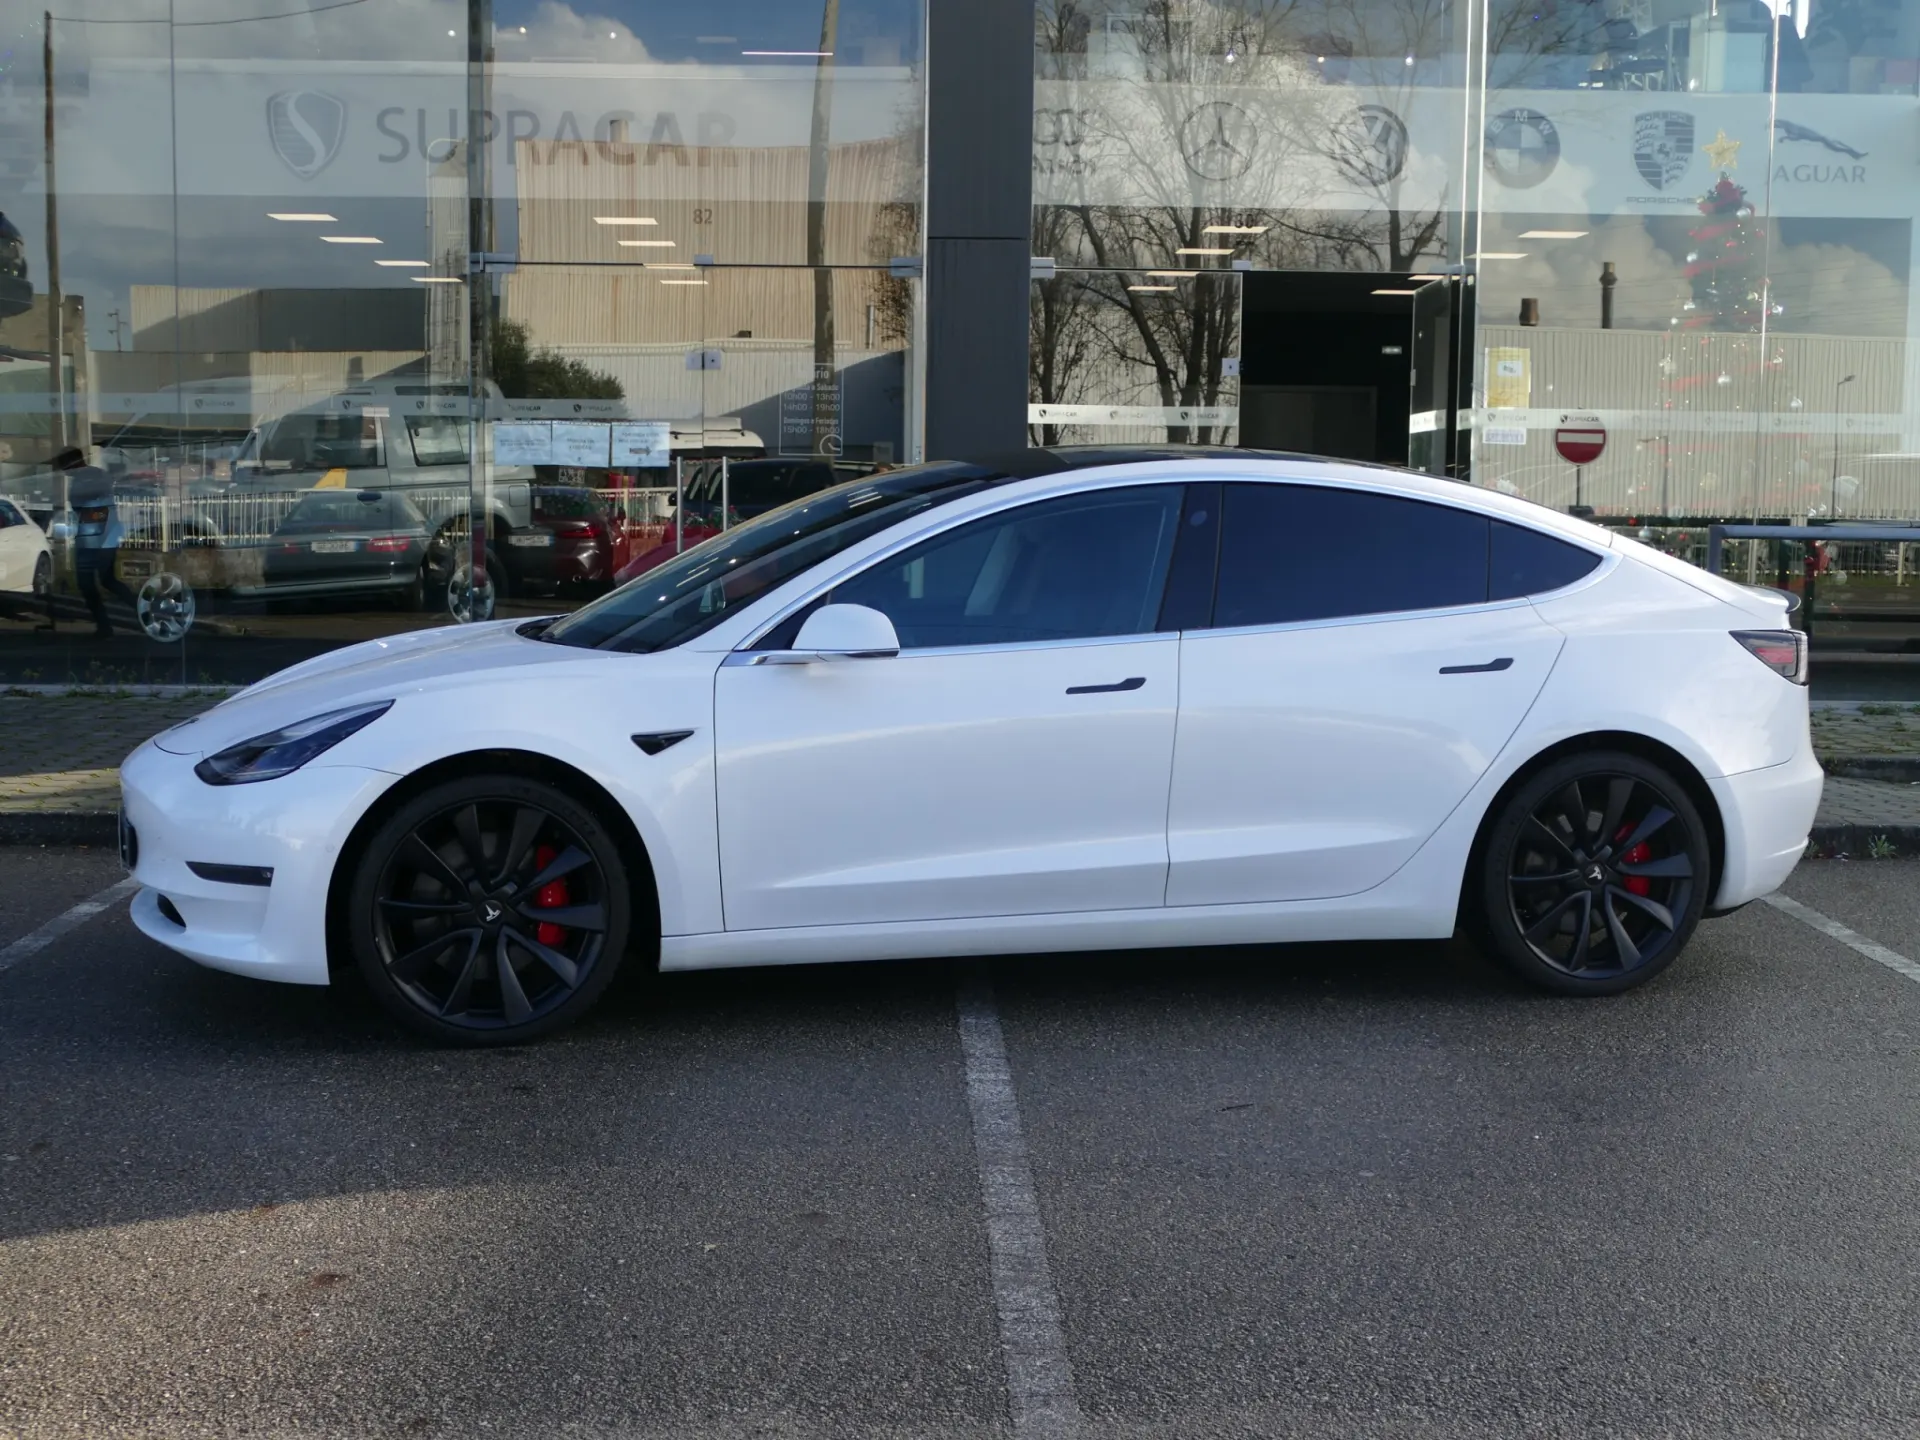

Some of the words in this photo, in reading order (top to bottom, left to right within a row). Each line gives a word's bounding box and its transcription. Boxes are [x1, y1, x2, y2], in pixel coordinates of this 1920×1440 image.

[375, 106, 740, 168] SUPRACAR
[1772, 164, 1867, 183] AGUAR
[693, 208, 713, 225] 82
